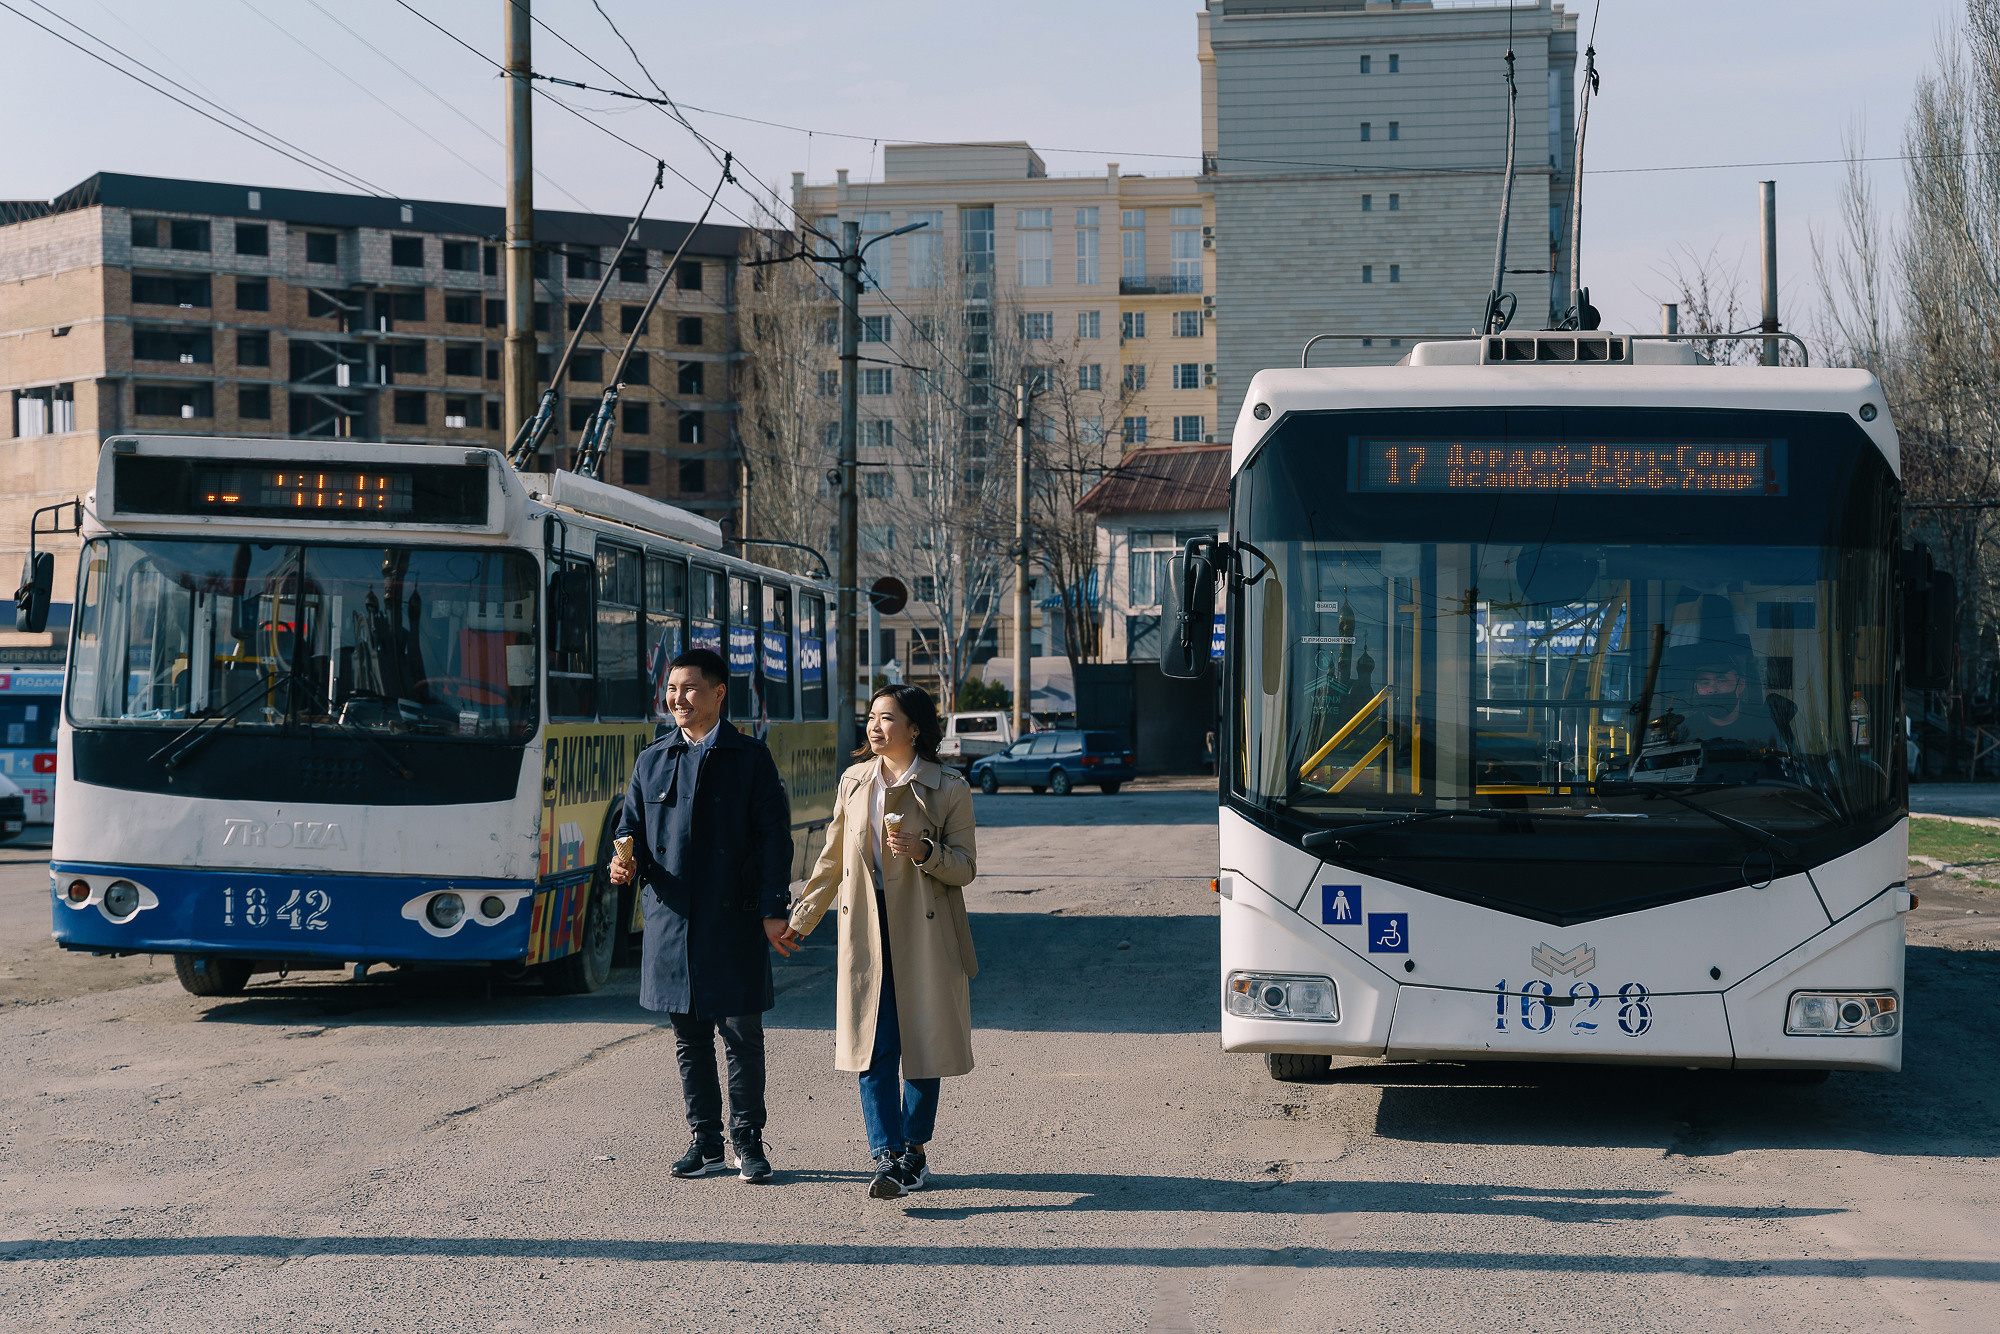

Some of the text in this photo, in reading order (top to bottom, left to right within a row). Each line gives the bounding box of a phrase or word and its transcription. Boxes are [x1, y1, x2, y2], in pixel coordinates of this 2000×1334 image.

[1386, 446, 1426, 484] 17
[558, 734, 625, 807] AKADEMIYA
[223, 818, 348, 851] TROLZA
[223, 887, 331, 930] 1842
[1494, 978, 1653, 1038] 1628
